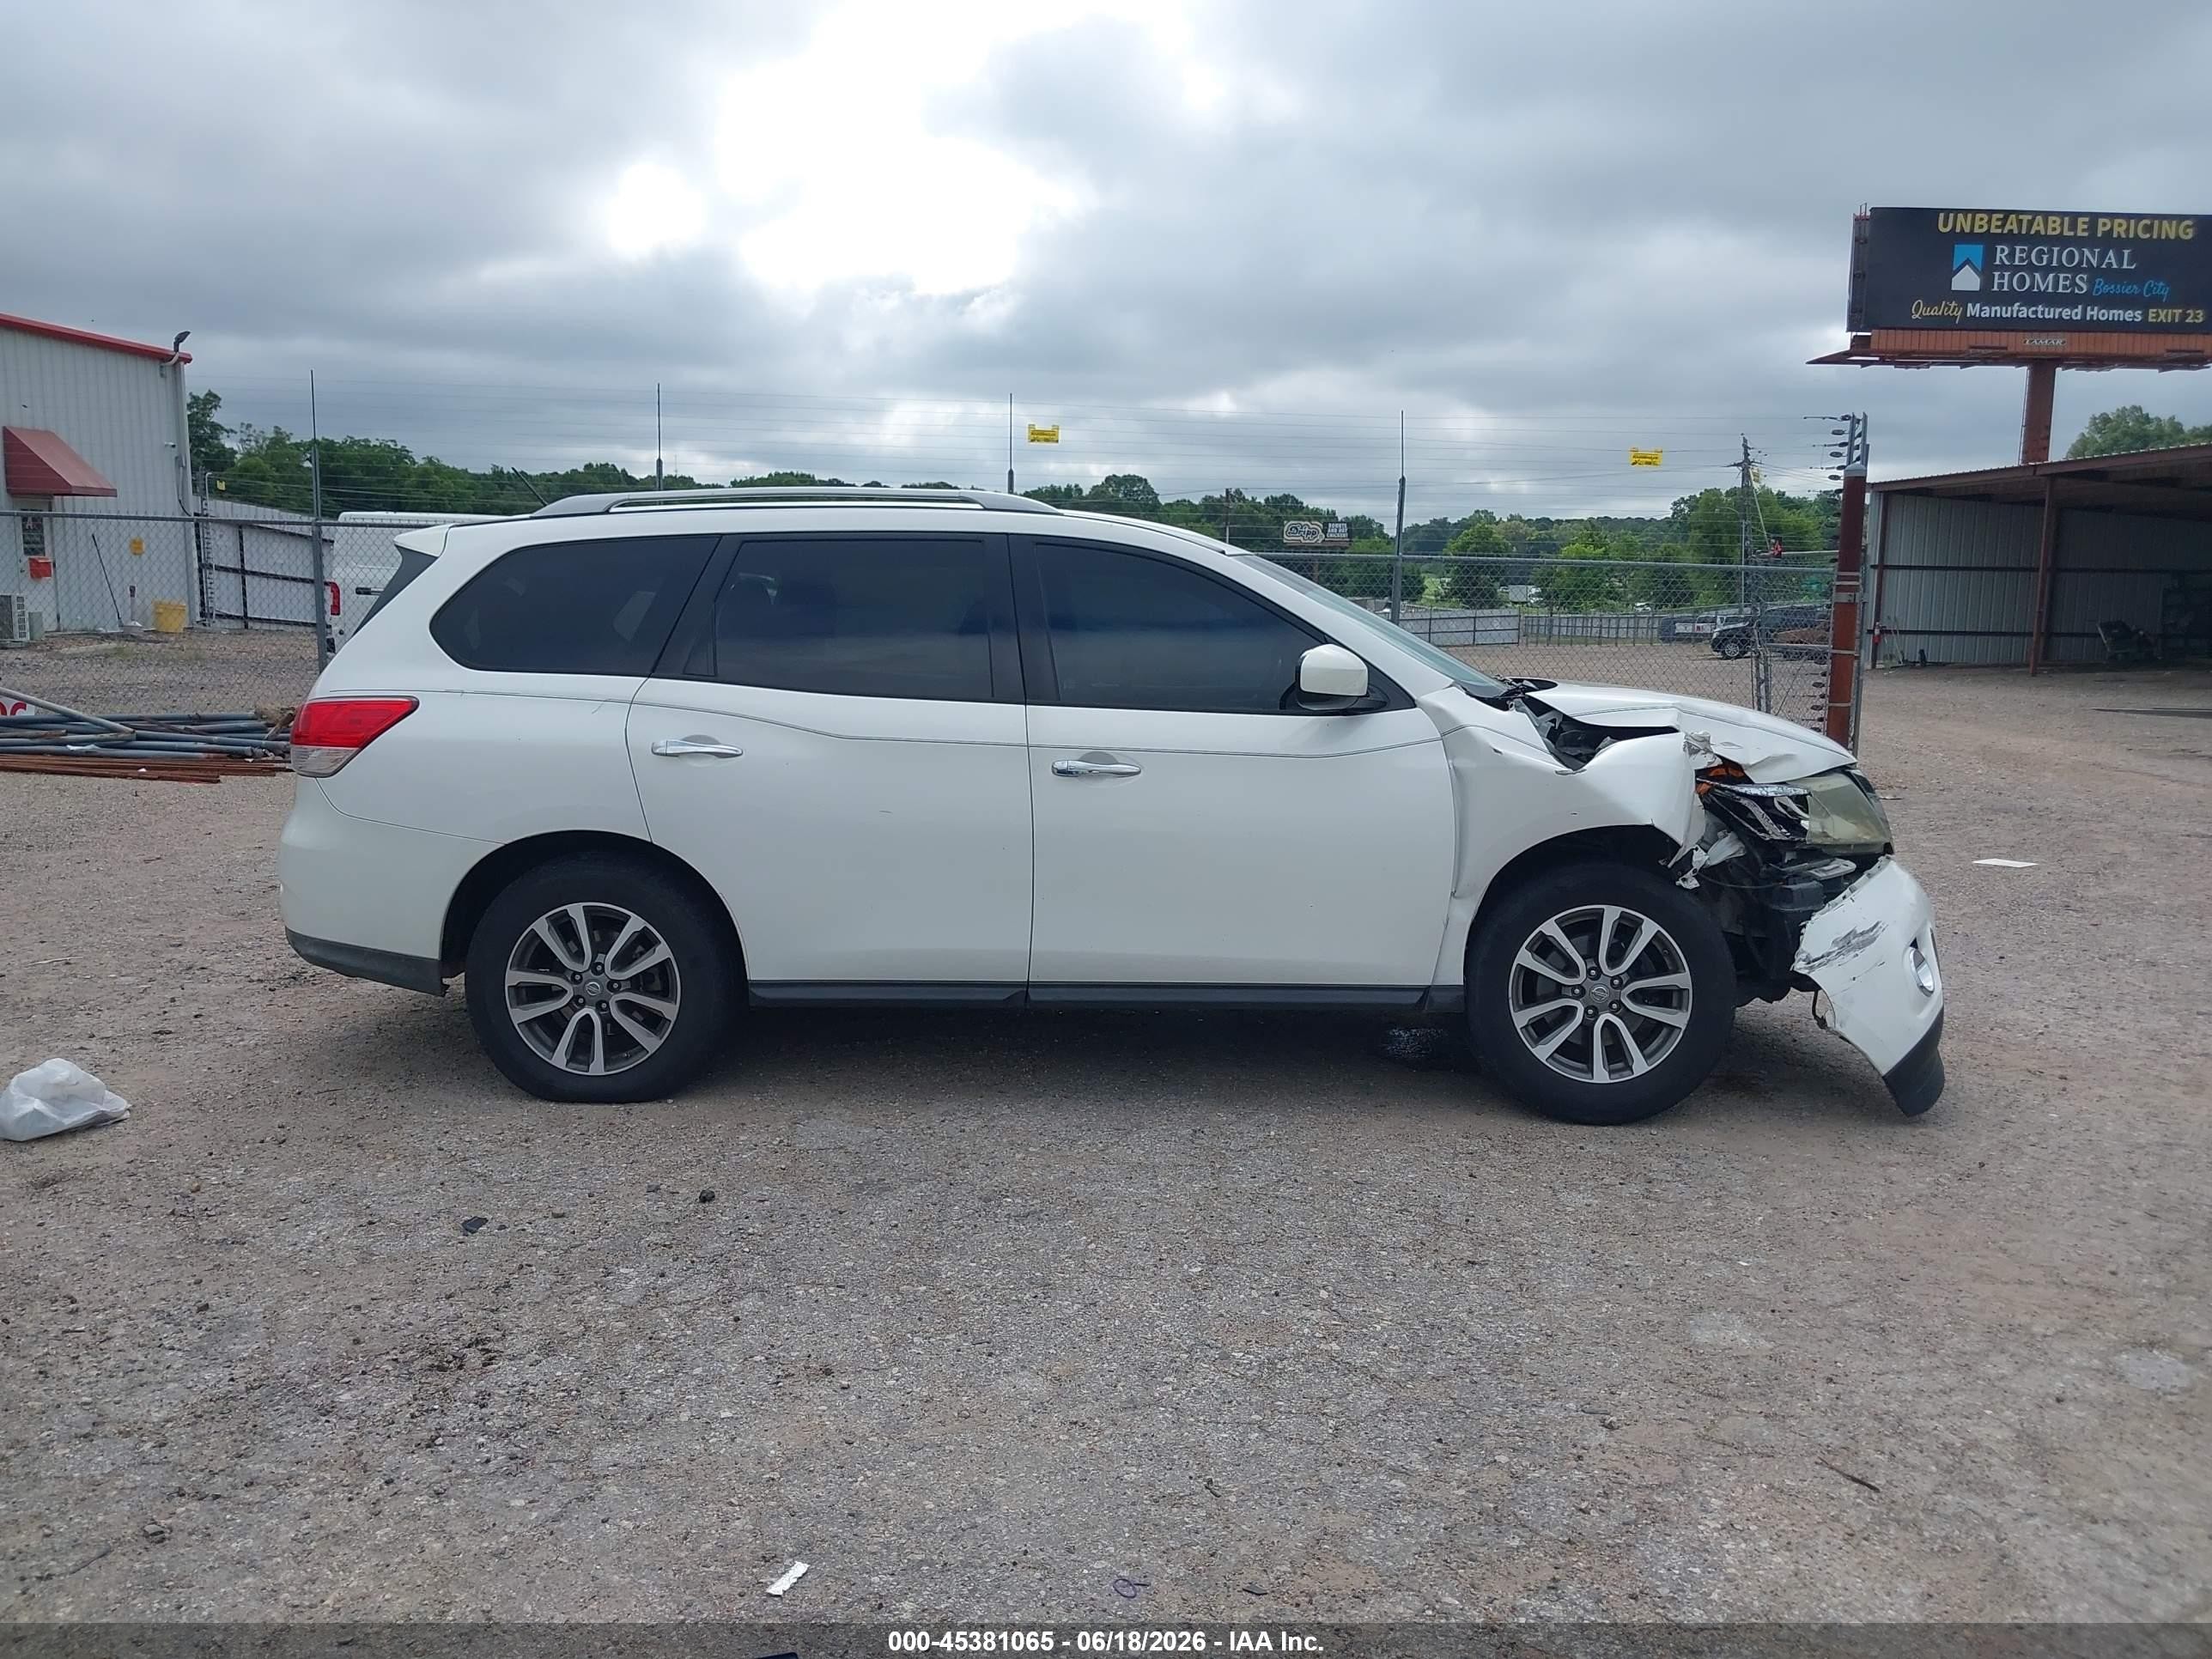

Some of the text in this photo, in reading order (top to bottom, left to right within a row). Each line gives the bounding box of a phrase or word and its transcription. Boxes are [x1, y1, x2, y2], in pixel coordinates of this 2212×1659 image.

[1937, 212, 2194, 240] UNBEATABLE PRICING
[1993, 245, 2136, 269] REGIONAL
[1991, 271, 2170, 302] HOMES Bossier City
[1911, 299, 2203, 325] Quality Manufactured Homes EXIT 23
[2025, 337, 2063, 346] LAMAR
